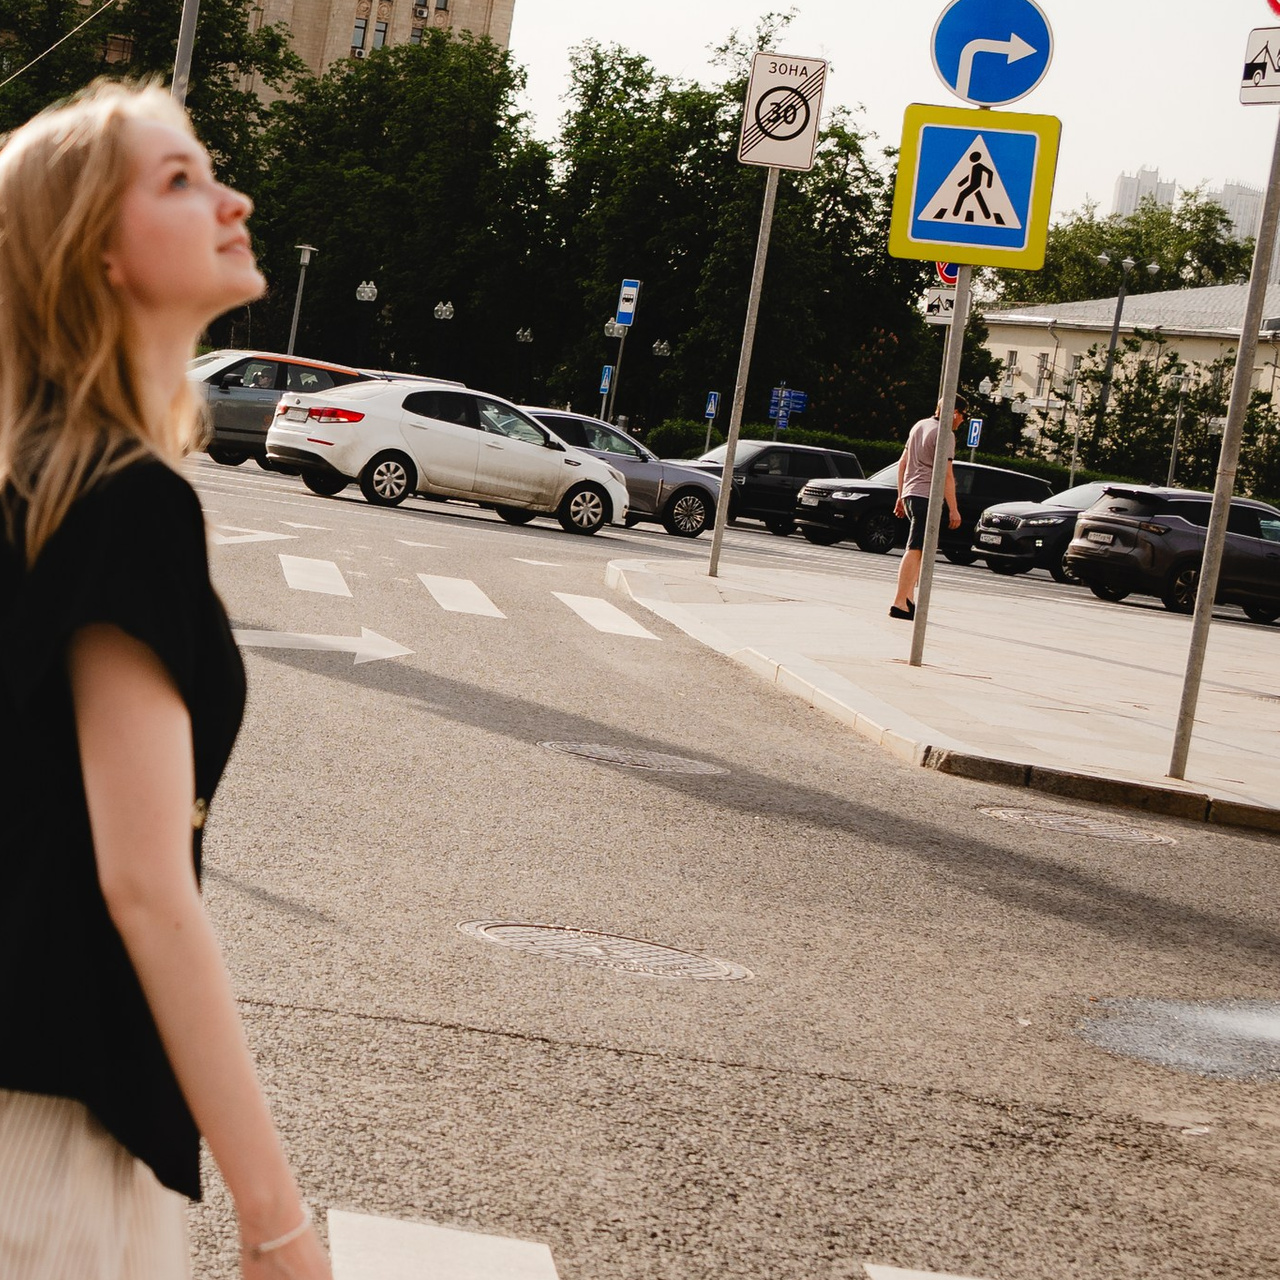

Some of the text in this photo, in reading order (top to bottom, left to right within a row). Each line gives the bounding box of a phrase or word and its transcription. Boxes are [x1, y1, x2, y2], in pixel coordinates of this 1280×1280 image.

[768, 61, 809, 78] ЗОНА
[768, 102, 797, 126] 30
[971, 422, 980, 444] P
